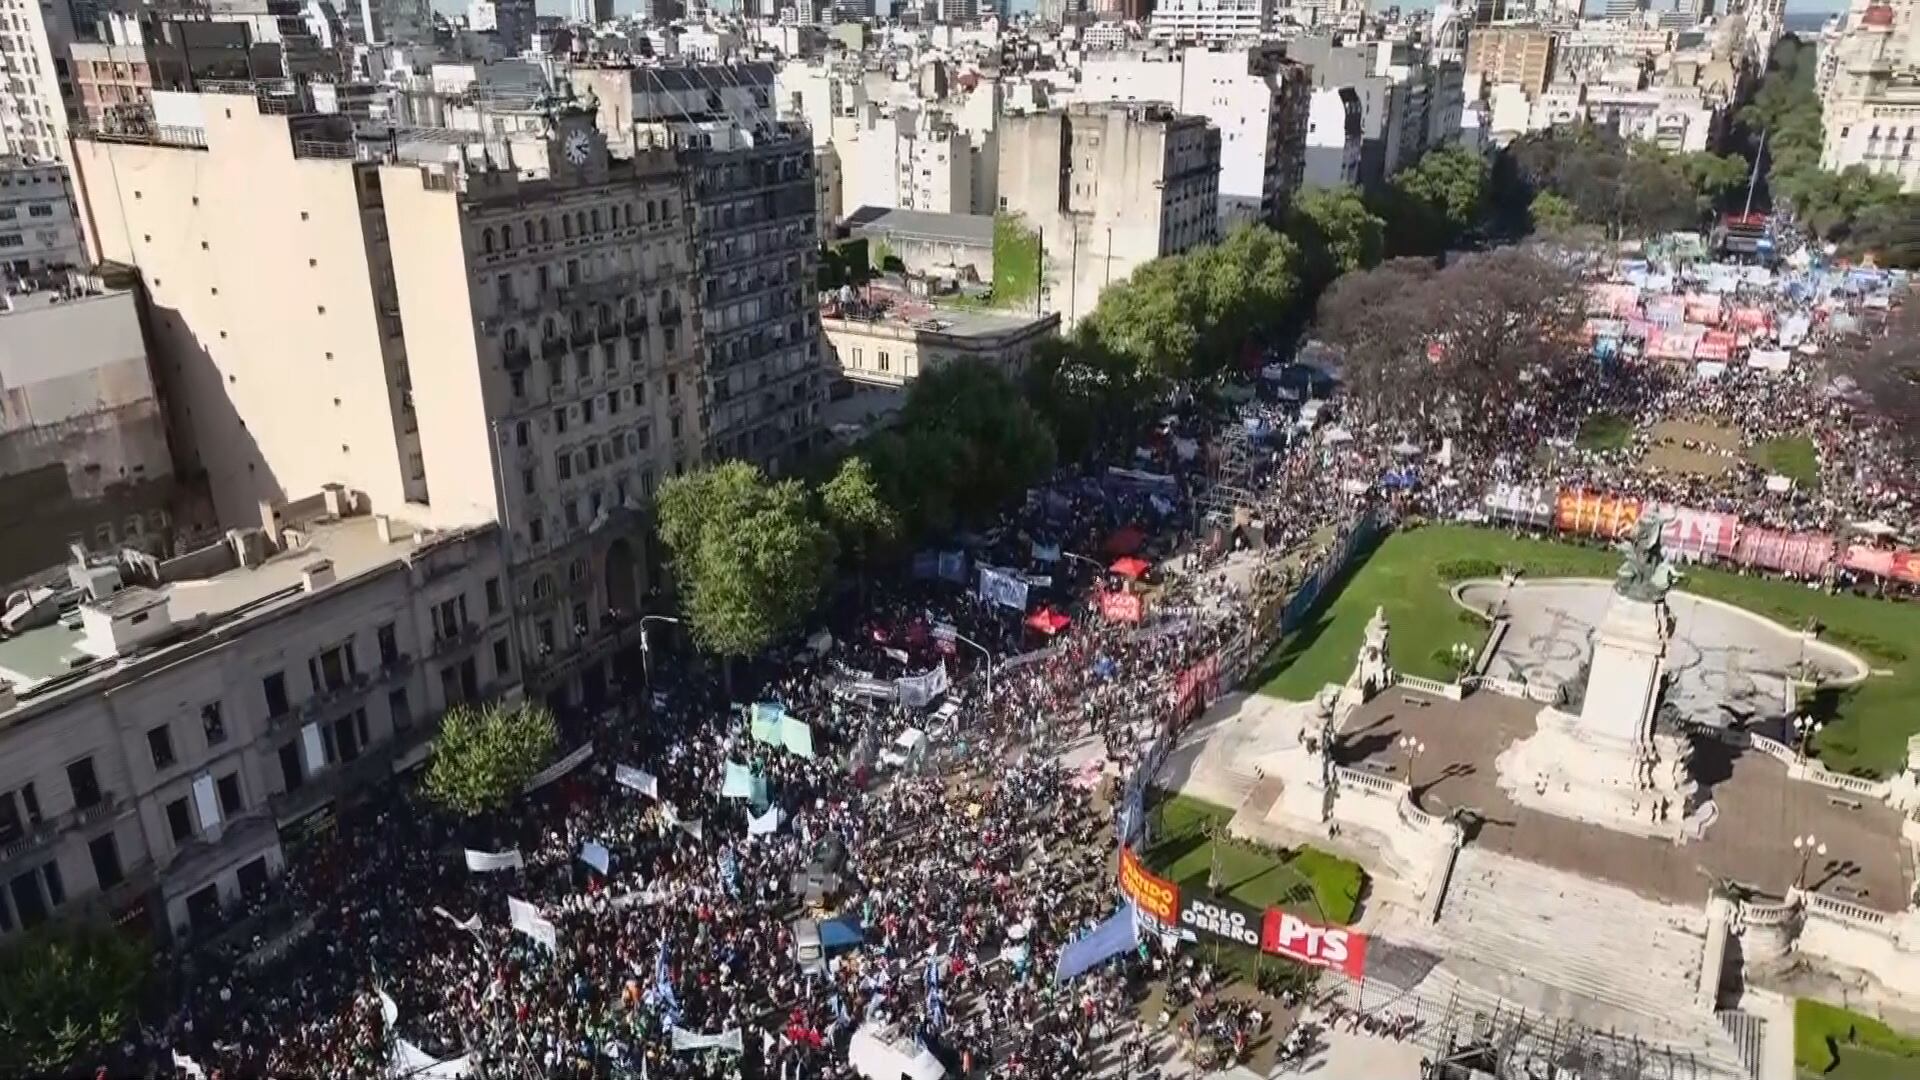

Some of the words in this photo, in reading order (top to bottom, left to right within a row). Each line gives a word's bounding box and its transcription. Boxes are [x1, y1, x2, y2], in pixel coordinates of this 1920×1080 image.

[1181, 909, 1259, 945] OBRERO
[1192, 899, 1246, 926] POLO
[1279, 913, 1348, 961] PTS
